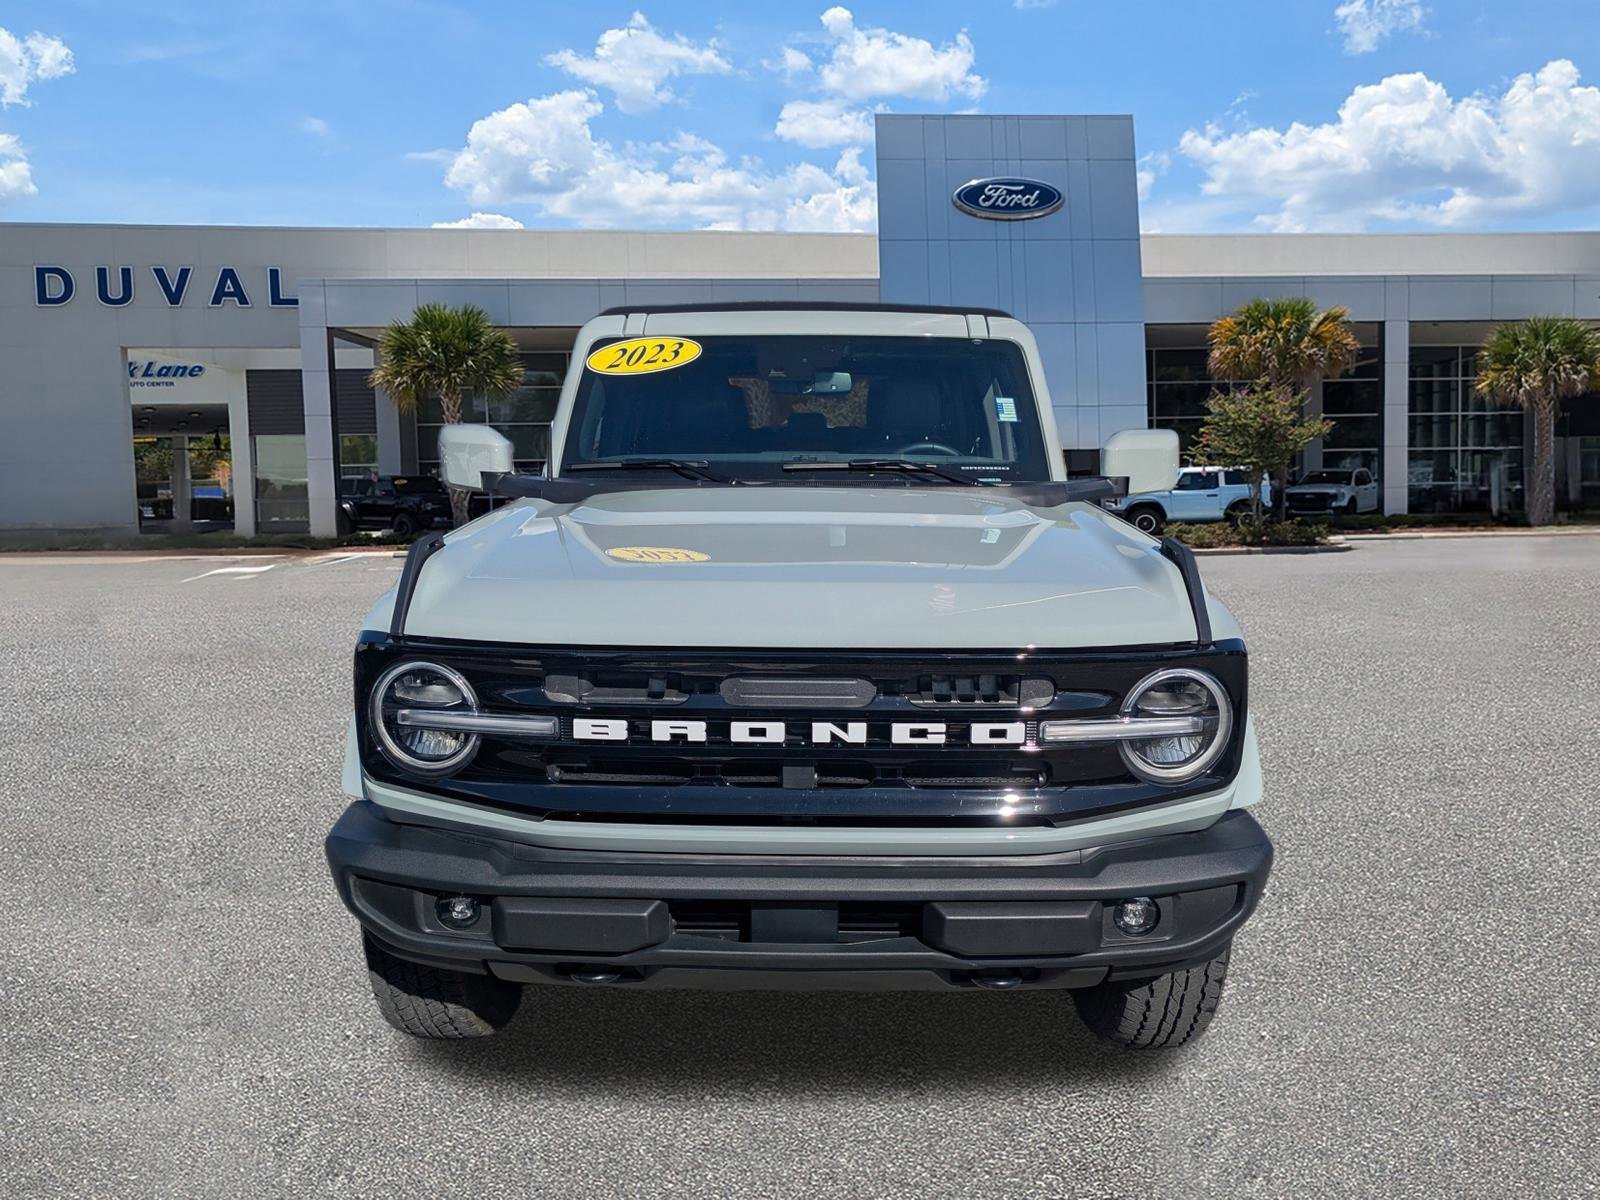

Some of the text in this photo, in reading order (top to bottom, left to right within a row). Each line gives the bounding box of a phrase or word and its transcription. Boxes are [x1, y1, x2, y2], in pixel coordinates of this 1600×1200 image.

[978, 184, 1041, 207] Ford
[34, 265, 299, 307] DUVAL
[605, 341, 685, 370] 2023
[142, 361, 203, 378] Lane
[572, 718, 1026, 744] BRONCO
